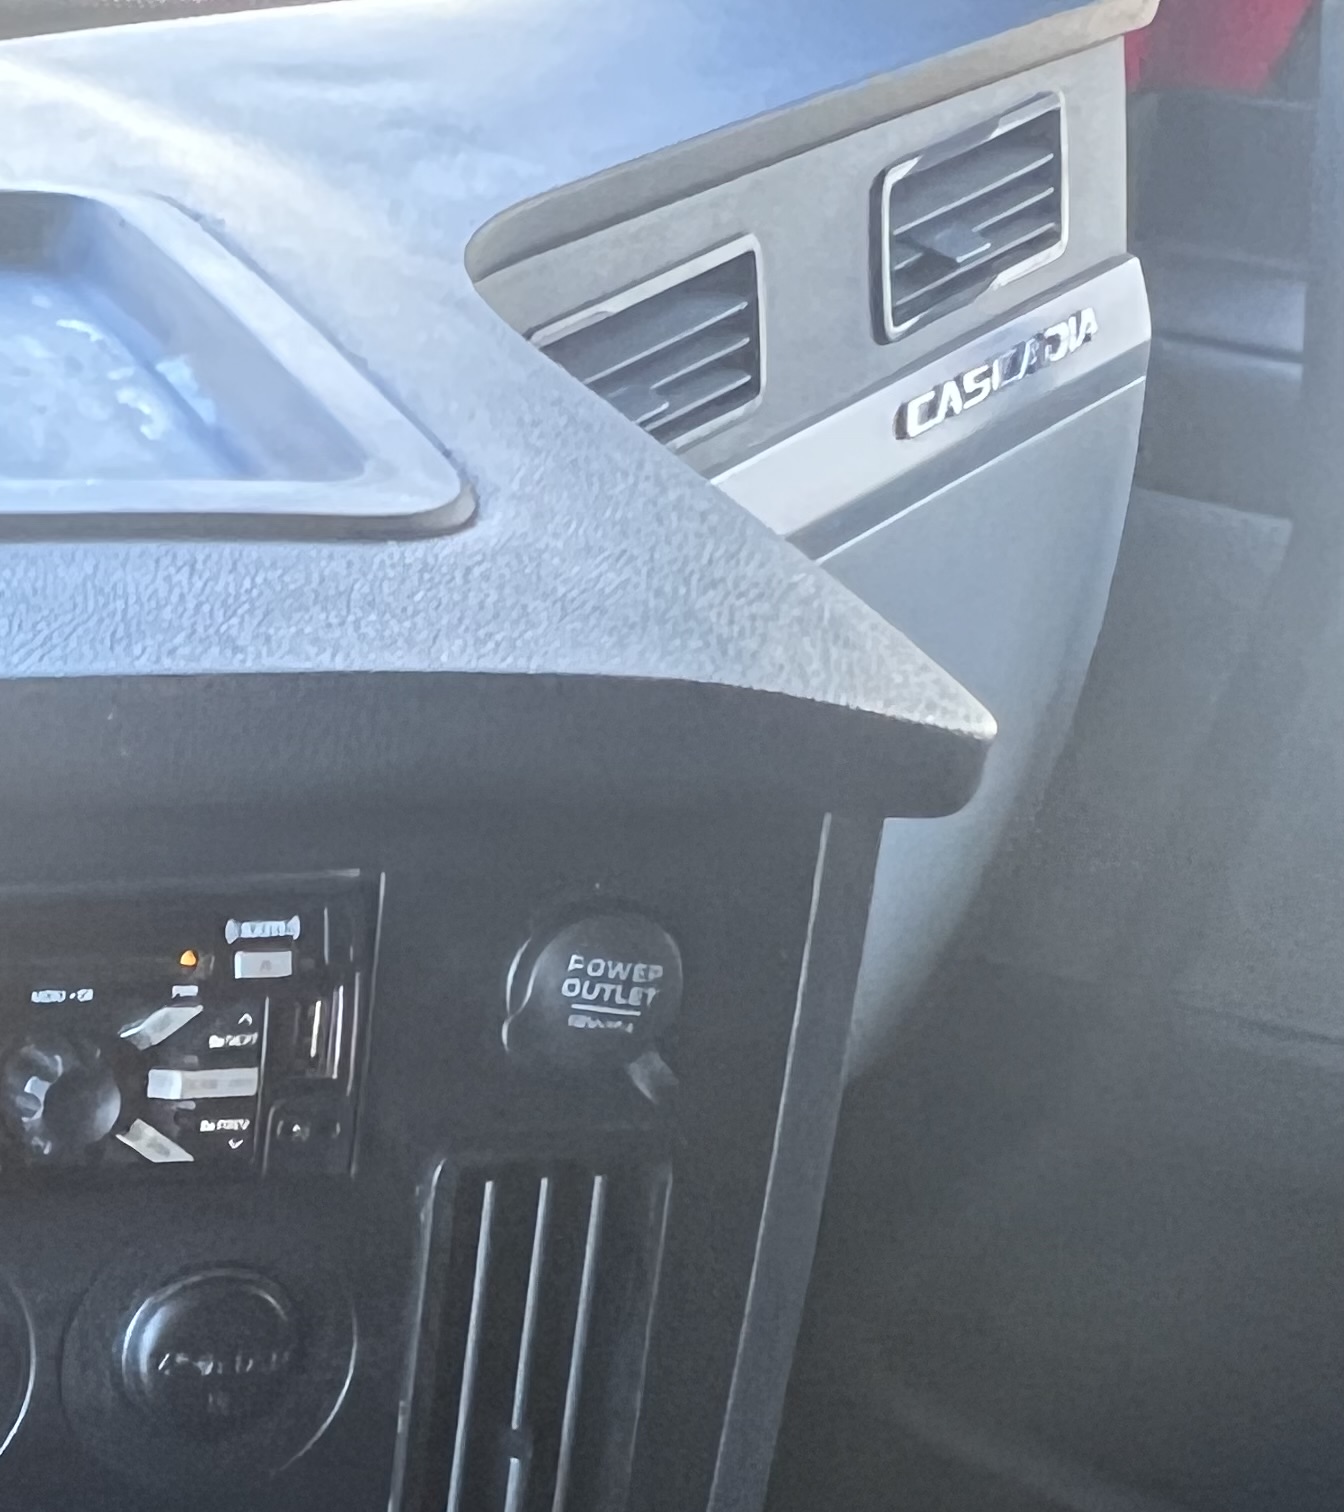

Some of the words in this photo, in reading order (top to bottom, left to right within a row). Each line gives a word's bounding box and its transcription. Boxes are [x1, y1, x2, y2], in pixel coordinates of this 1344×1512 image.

[894, 307, 1099, 440] CASCADIA
[568, 954, 663, 982] POWER
[562, 978, 660, 1007] OUTLET
